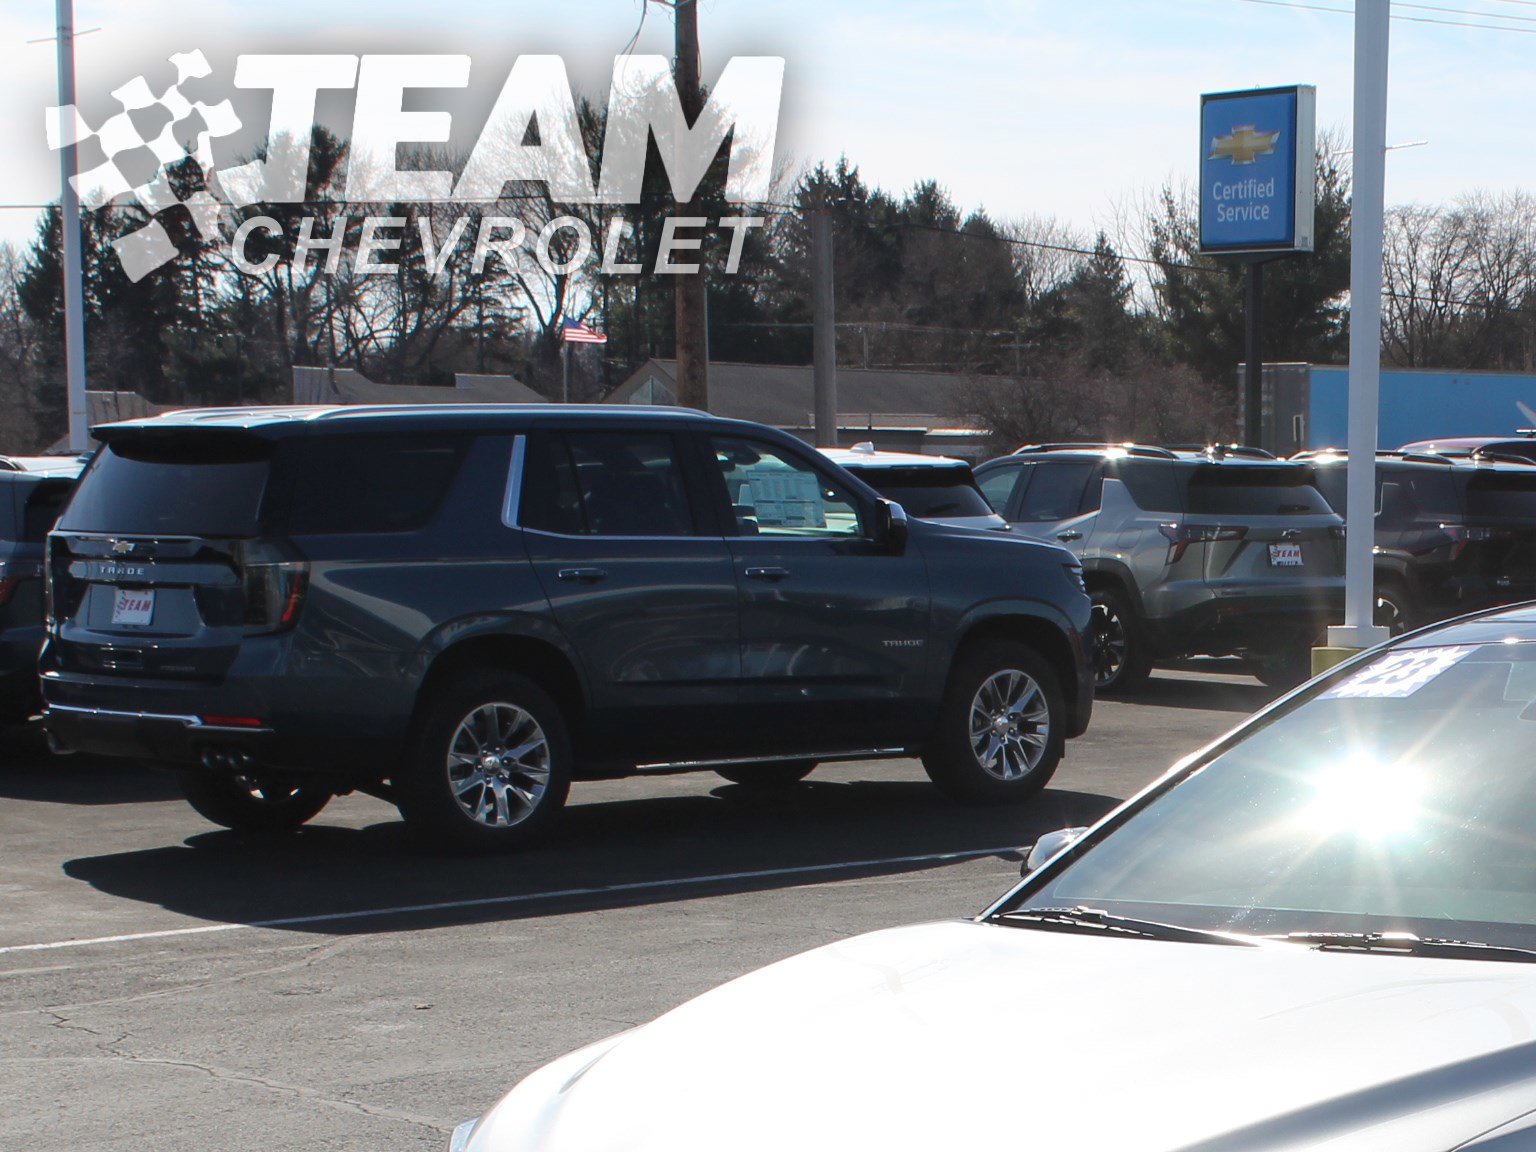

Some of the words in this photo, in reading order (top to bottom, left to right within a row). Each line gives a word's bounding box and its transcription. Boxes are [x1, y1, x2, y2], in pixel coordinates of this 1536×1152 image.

[1213, 177, 1274, 200] Certified
[1217, 202, 1269, 222] Service
[1275, 550, 1300, 558] TEAM
[119, 599, 152, 612] TEAM
